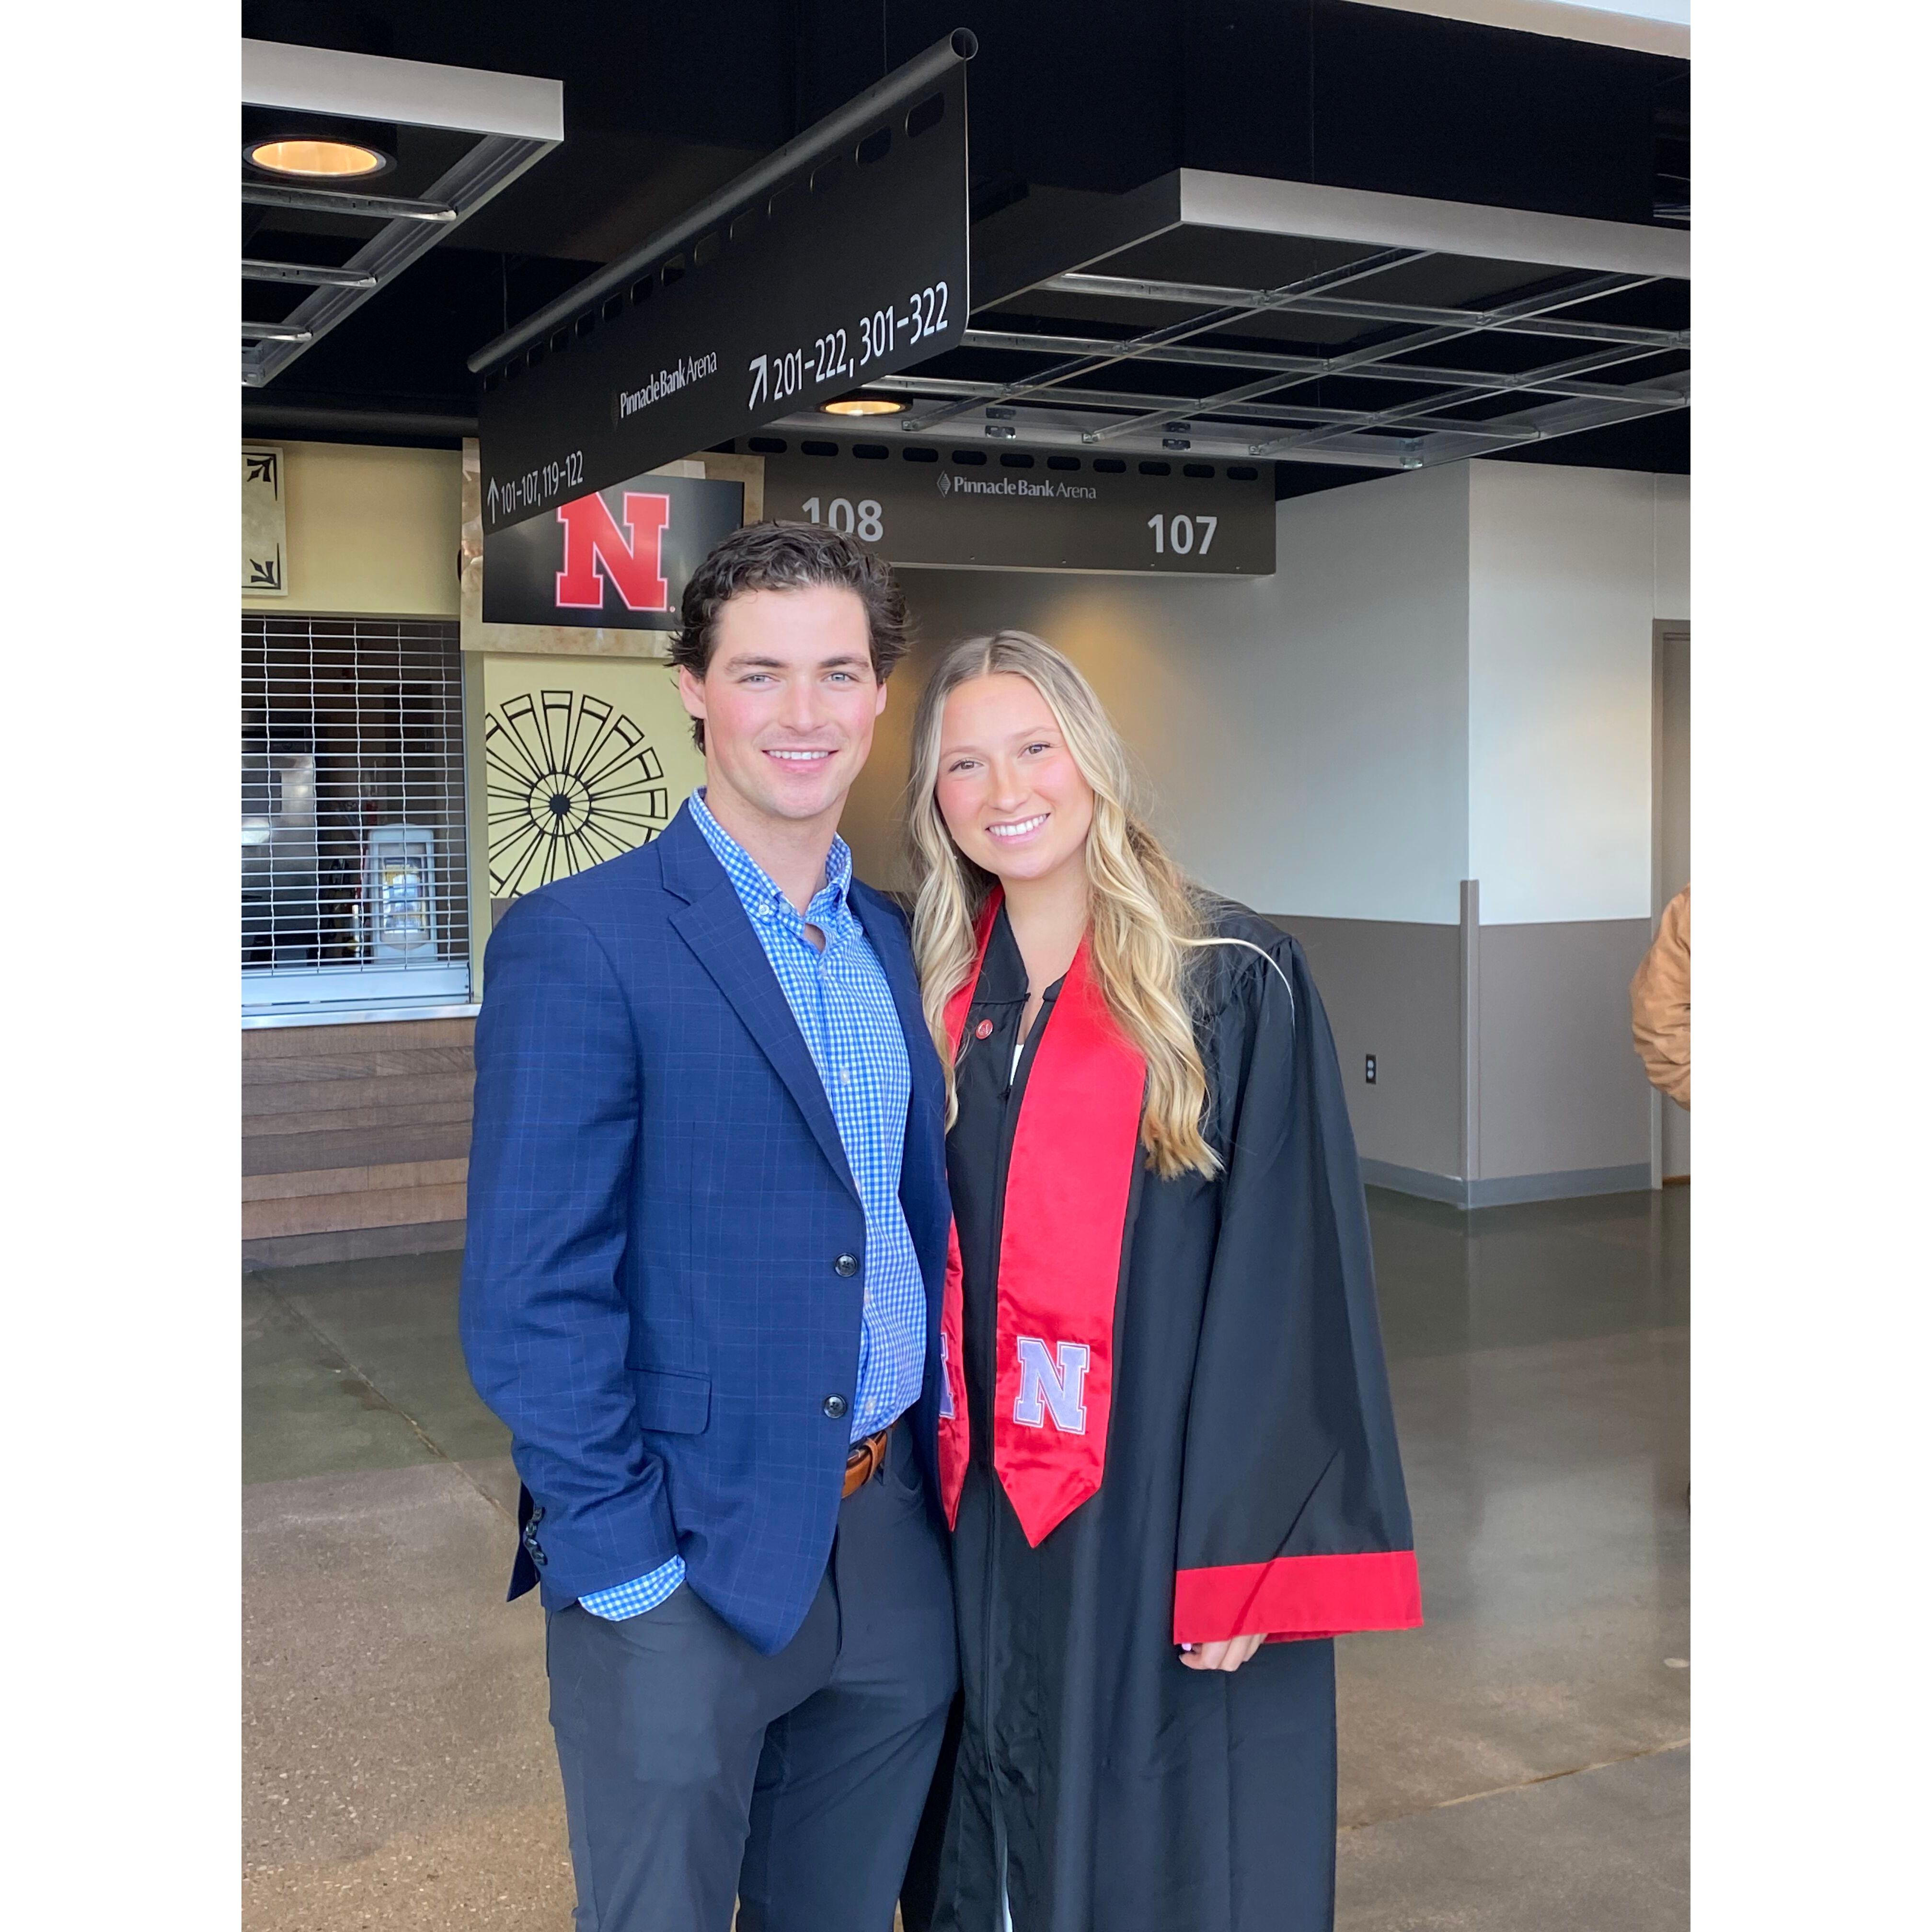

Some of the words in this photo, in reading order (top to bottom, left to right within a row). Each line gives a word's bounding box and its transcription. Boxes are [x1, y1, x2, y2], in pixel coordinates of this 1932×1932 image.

[773, 328, 854, 401] 201-222,
[860, 281, 948, 366] 301-322
[620, 373, 660, 419] Pinnacle
[660, 358, 686, 398] Bank
[686, 351, 717, 385] Arena
[543, 449, 584, 498] 119-122
[954, 476, 1016, 495] Pinnacle
[1018, 480, 1054, 497] Bank
[1055, 482, 1097, 499] Arena
[802, 496, 884, 542] 108
[1148, 514, 1218, 555] 107
[556, 491, 669, 612] N
[1012, 1335, 1090, 1436] N
